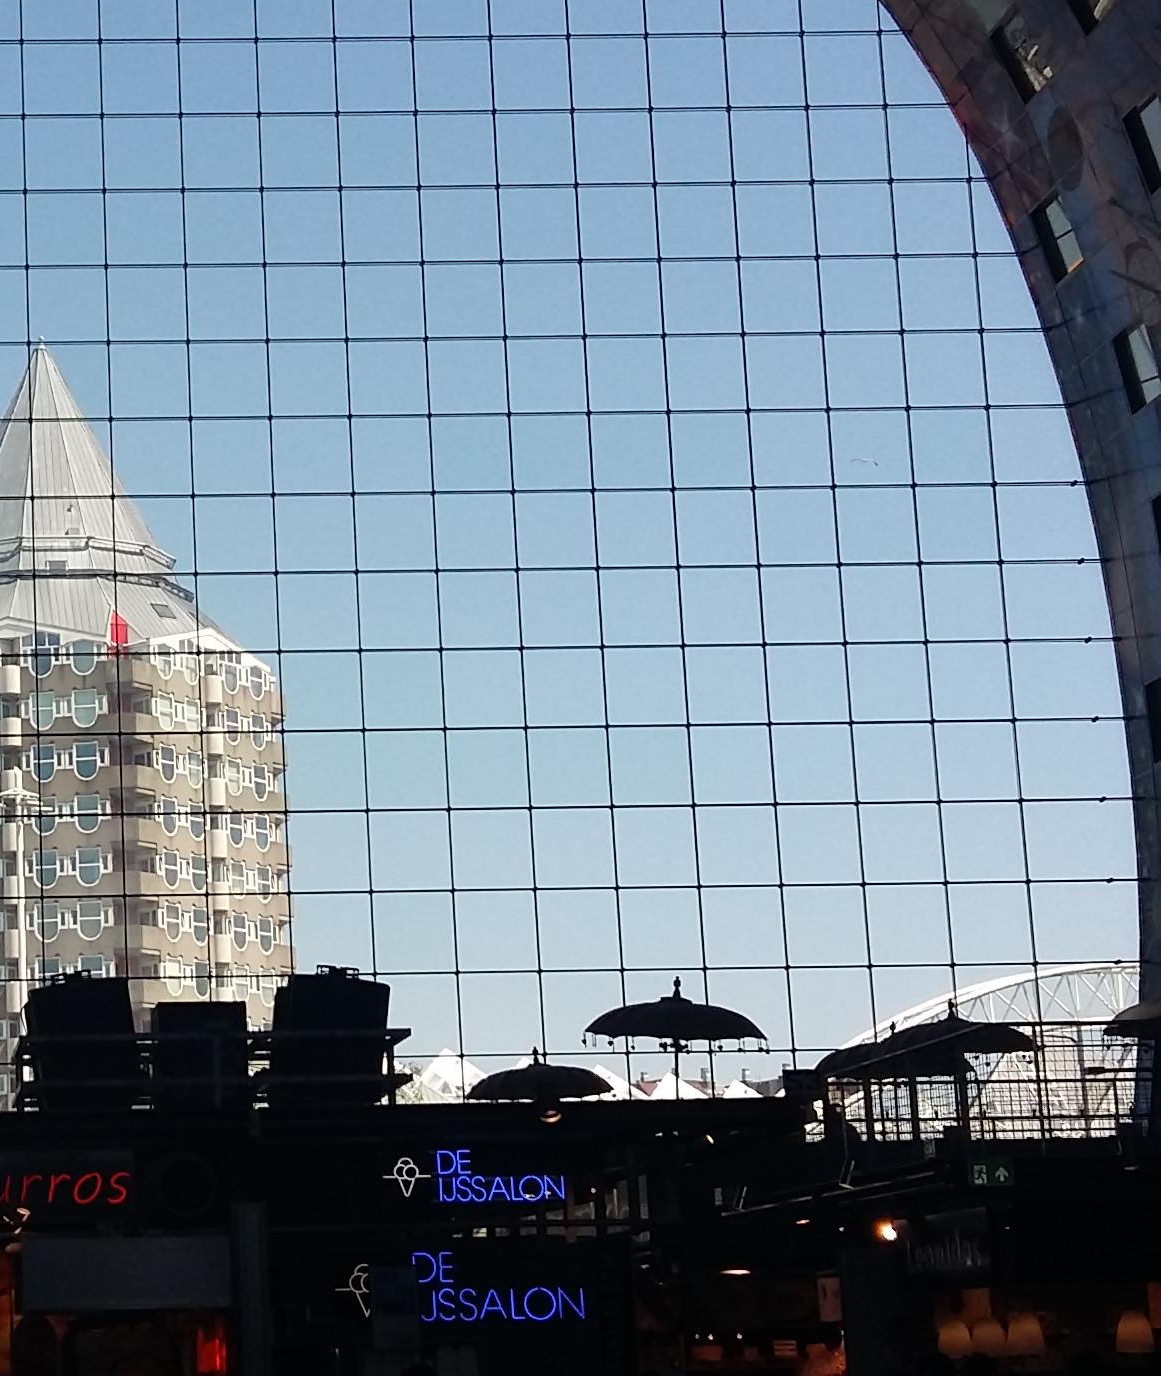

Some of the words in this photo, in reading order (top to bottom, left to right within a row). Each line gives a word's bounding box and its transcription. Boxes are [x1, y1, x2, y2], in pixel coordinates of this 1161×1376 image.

[436, 1149, 472, 1175] DE
[438, 1175, 566, 1202] IJSSALON
[412, 1251, 454, 1283] DE
[421, 1287, 586, 1321] JSSALON
